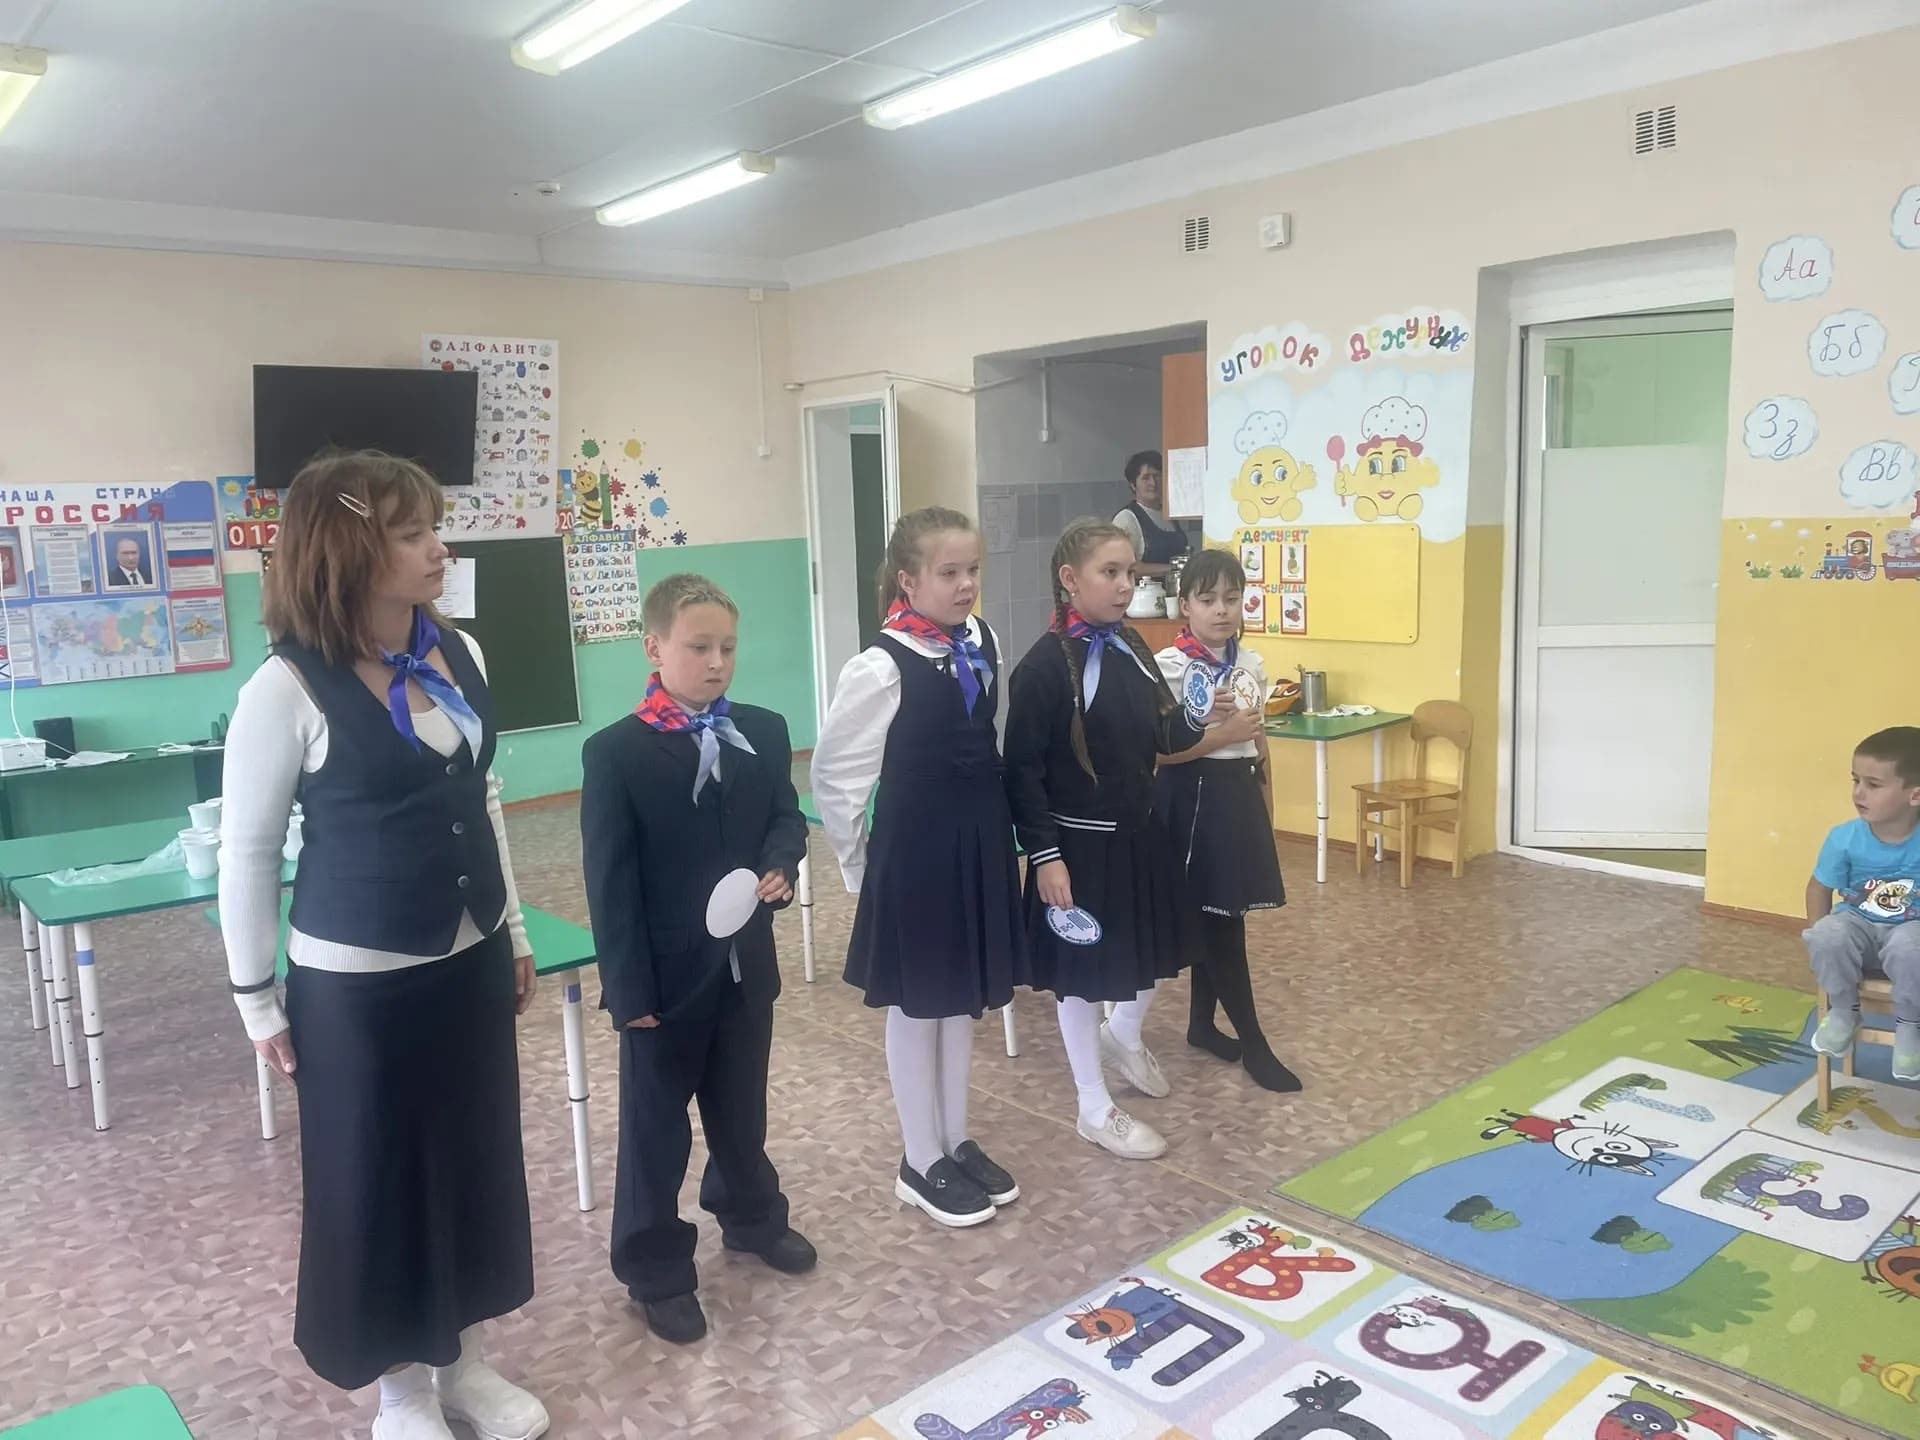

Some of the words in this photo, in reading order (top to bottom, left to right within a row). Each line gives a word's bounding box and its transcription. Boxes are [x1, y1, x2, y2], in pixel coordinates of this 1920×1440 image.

[446, 341, 537, 355] АЛФАВИТ
[6, 503, 165, 525] РОССИЯ
[574, 532, 625, 543] АЛФАВИТ
